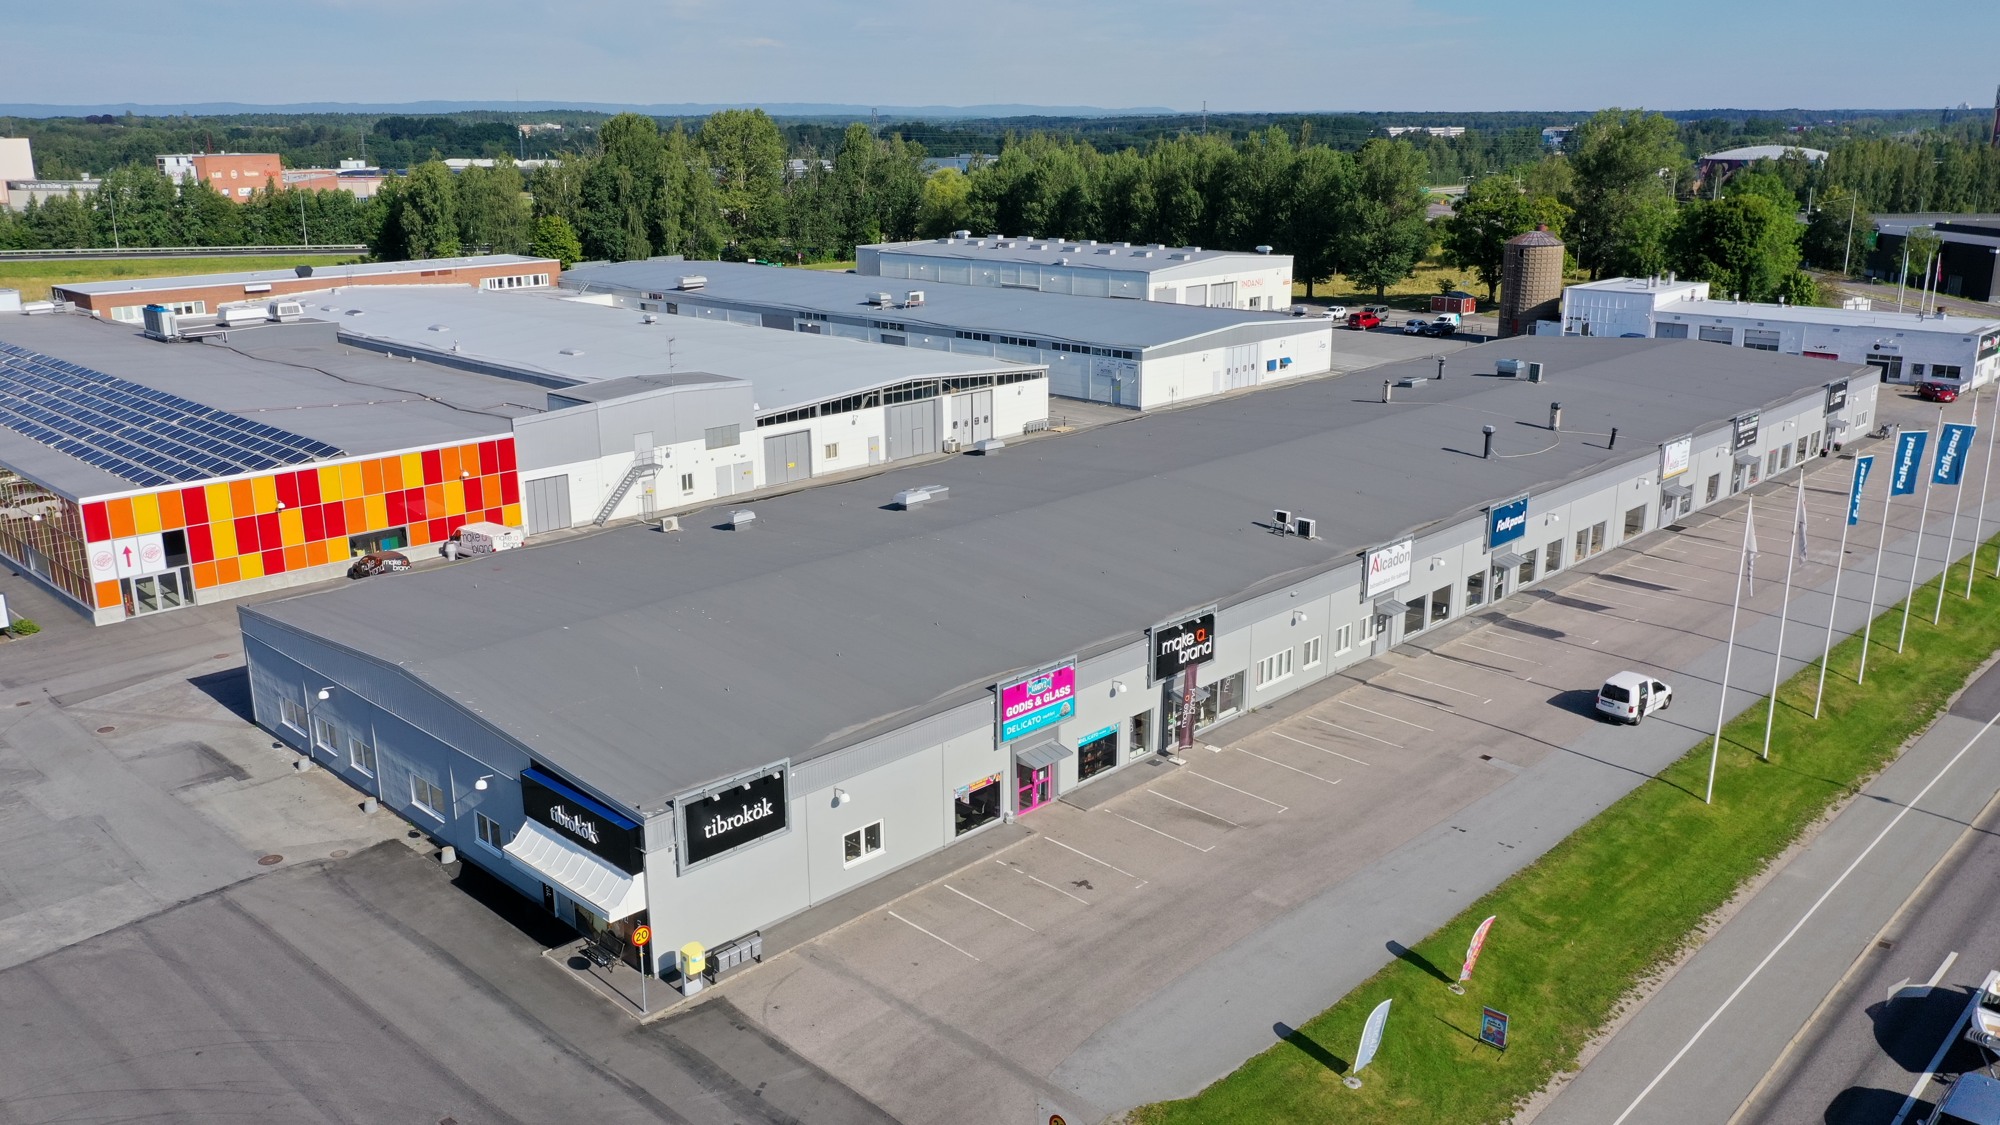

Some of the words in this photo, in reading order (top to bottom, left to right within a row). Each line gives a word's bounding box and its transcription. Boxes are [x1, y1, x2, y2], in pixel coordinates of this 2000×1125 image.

[1370, 551, 1410, 576] Alcadon
[1162, 632, 1195, 656] make
[1196, 628, 1205, 642] a
[1179, 635, 1213, 665] brand
[1006, 698, 1034, 718] GODIS
[1034, 696, 1042, 707] &
[1043, 684, 1071, 703] GLASS
[1006, 715, 1042, 735] DELICATO
[550, 804, 599, 844] tibrokök
[704, 797, 774, 839] tibrokök
[635, 929, 648, 942] 20
